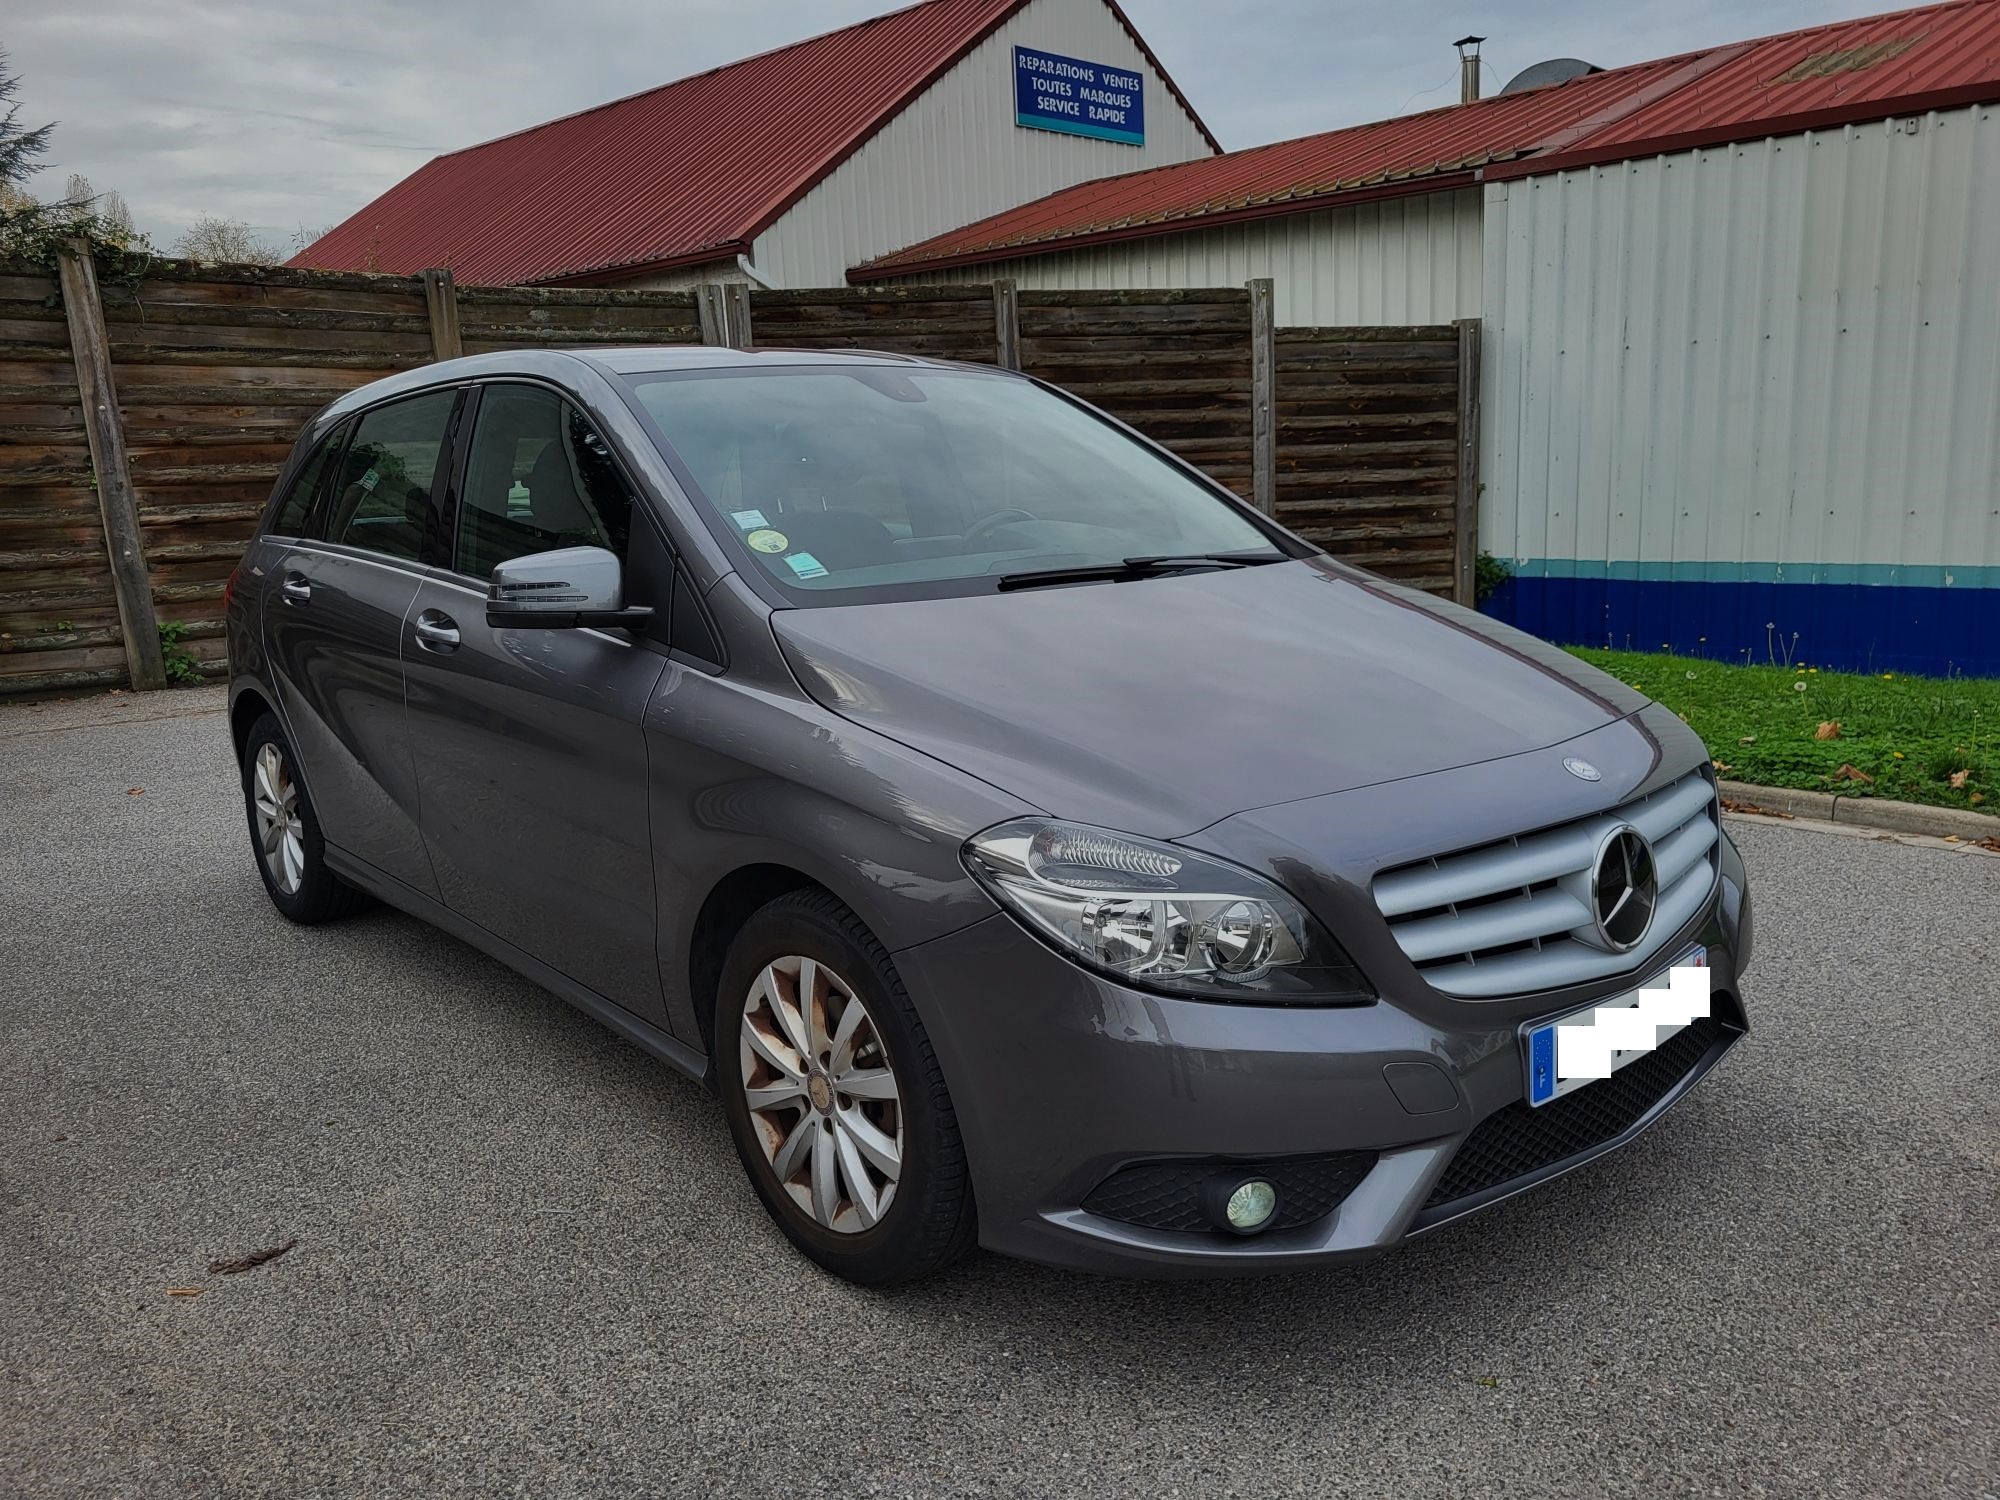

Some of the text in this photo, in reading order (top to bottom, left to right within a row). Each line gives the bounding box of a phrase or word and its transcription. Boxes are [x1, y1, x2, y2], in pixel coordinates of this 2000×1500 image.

[1019, 55, 1139, 91] REPARATIONS VENTES
[1032, 77, 1131, 108] TOUTES MARQUES
[1037, 96, 1126, 124] SERVICE RAPIDE
